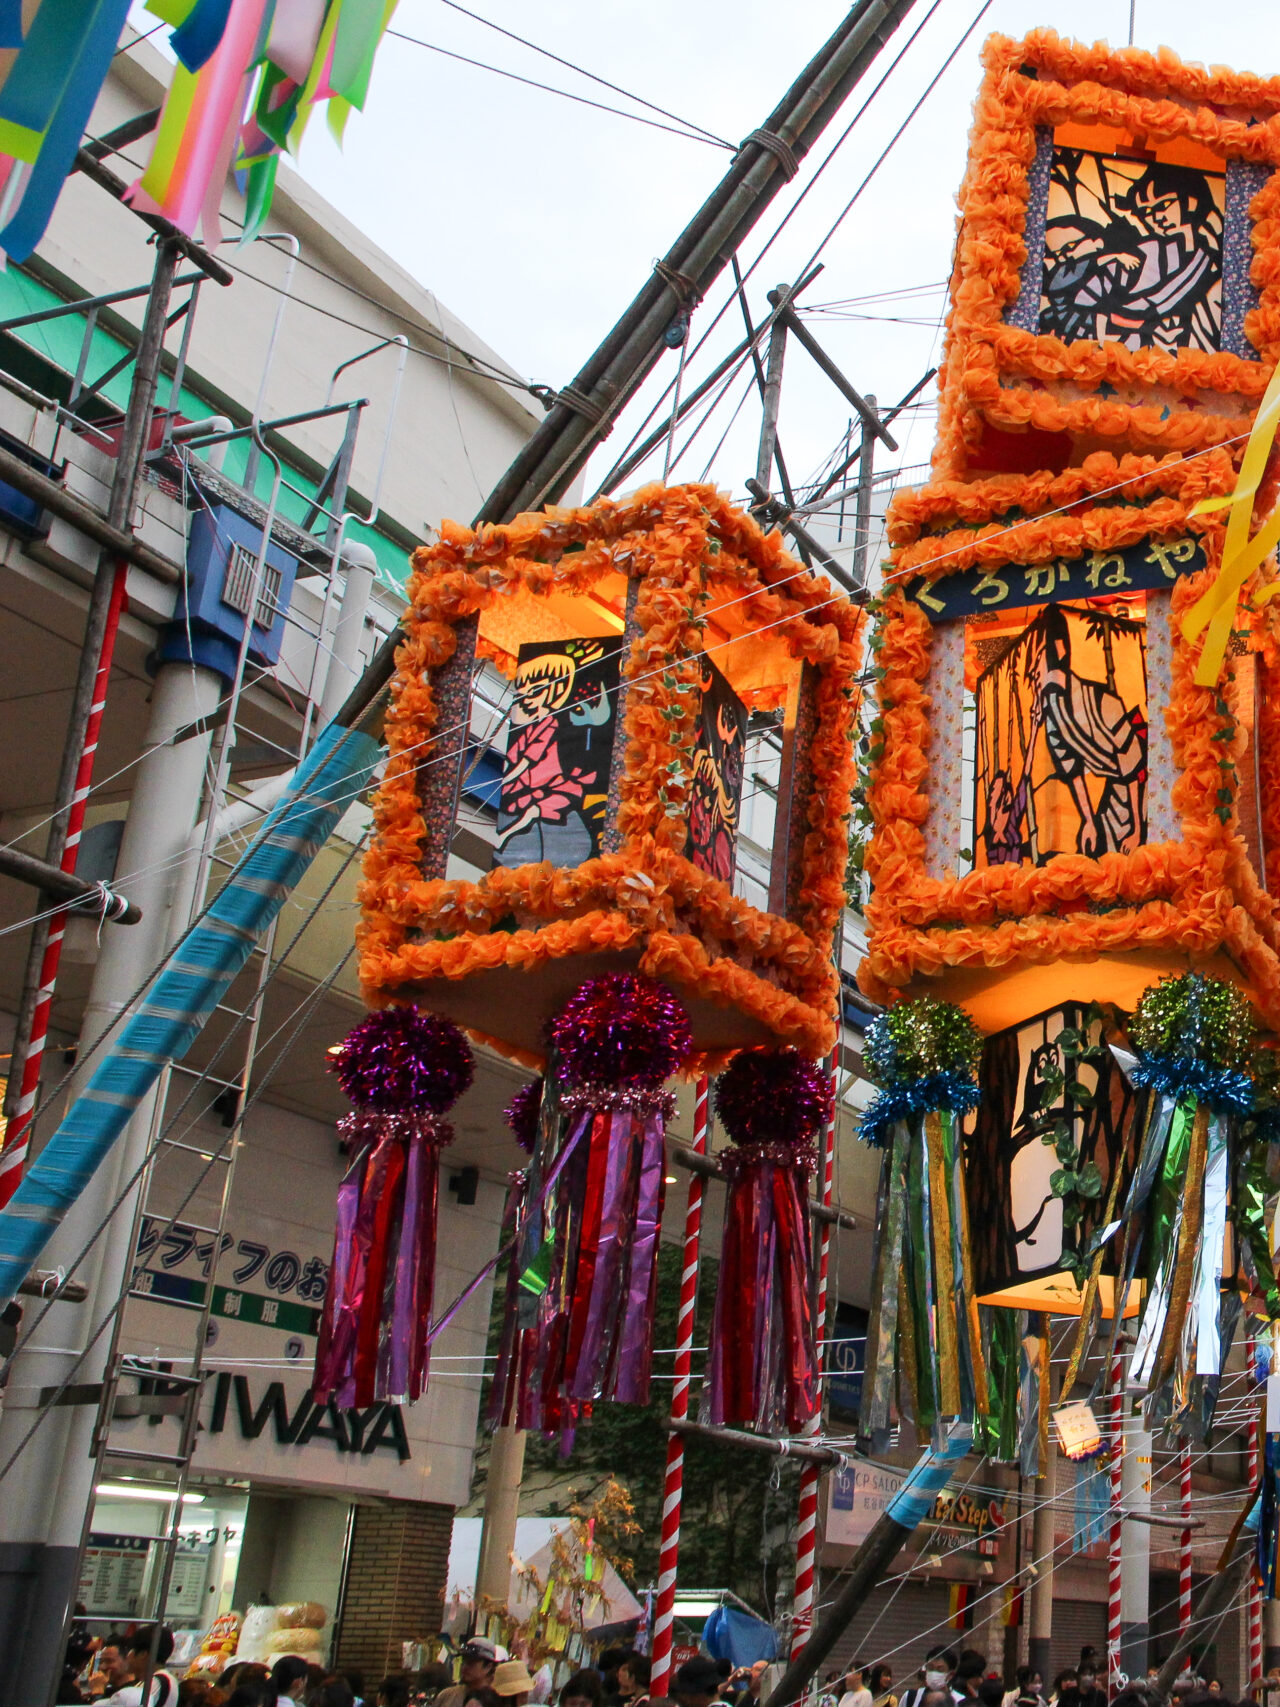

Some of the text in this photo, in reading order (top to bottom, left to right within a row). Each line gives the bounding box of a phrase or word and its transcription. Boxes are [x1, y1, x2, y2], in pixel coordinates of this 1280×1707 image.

[915, 536, 1197, 613] くろかねや
[855, 1472, 869, 1488] CP
[957, 1495, 989, 1535] Step
